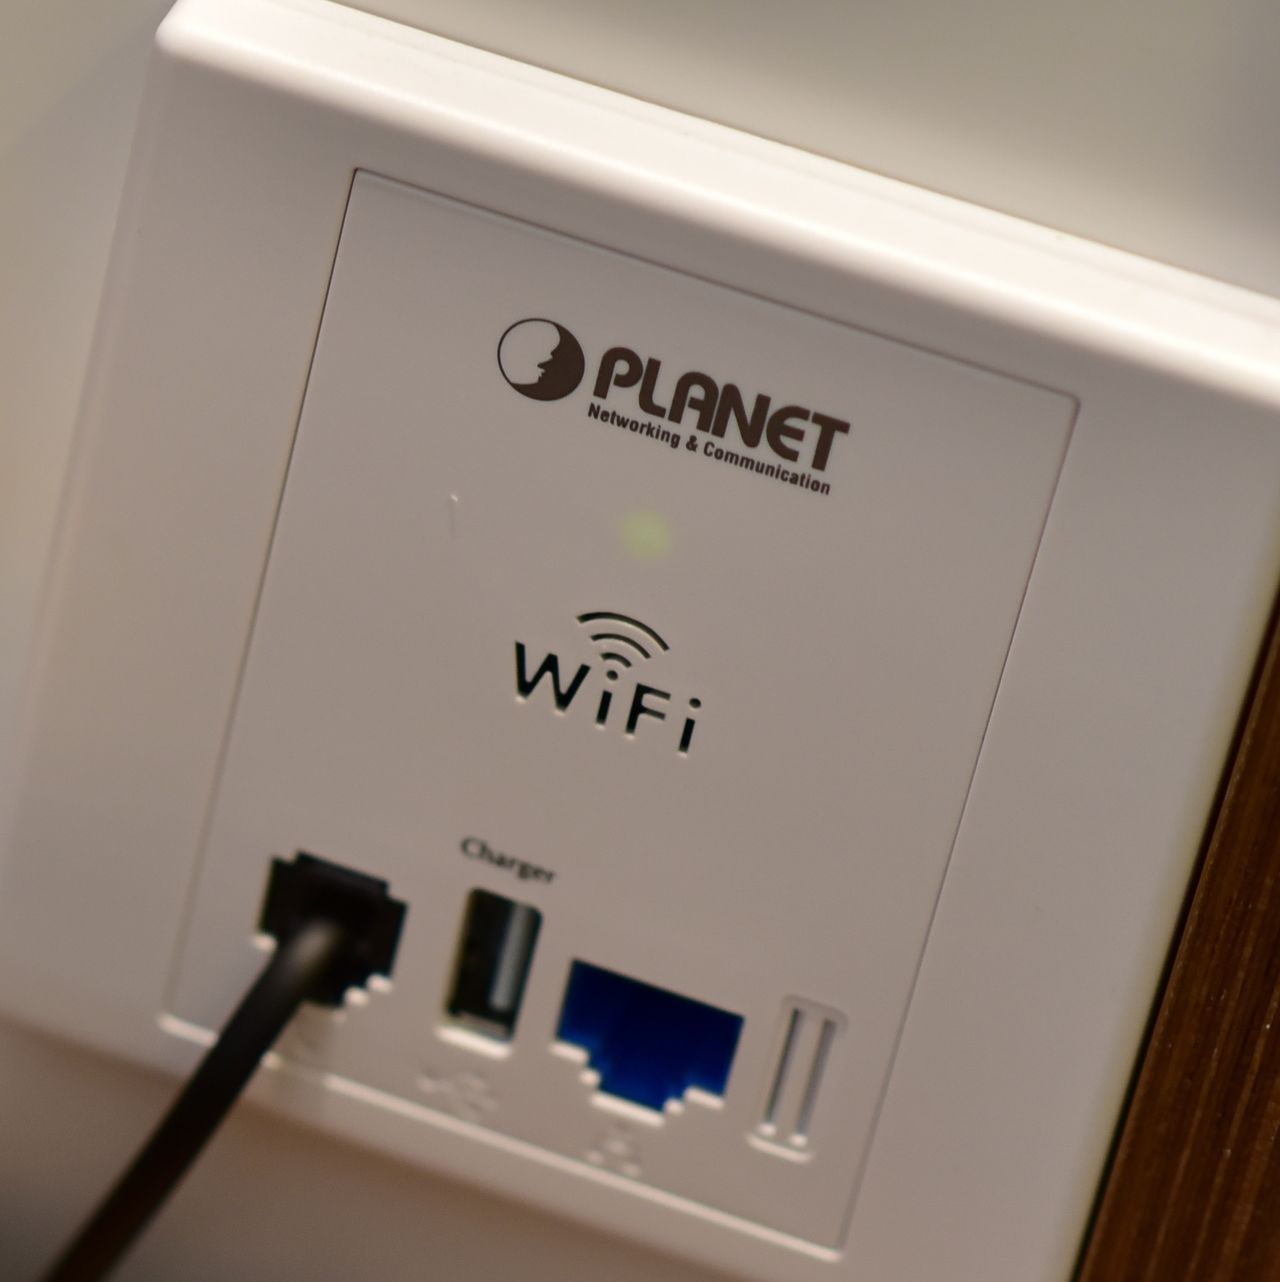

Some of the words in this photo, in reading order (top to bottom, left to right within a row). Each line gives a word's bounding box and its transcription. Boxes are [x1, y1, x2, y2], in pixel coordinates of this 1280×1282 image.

[587, 401, 681, 449] Networking
[685, 434, 699, 452] &
[702, 441, 832, 495] Communication
[592, 346, 852, 472] PLANET
[514, 640, 702, 754] WiFi
[459, 837, 557, 884] Charger
